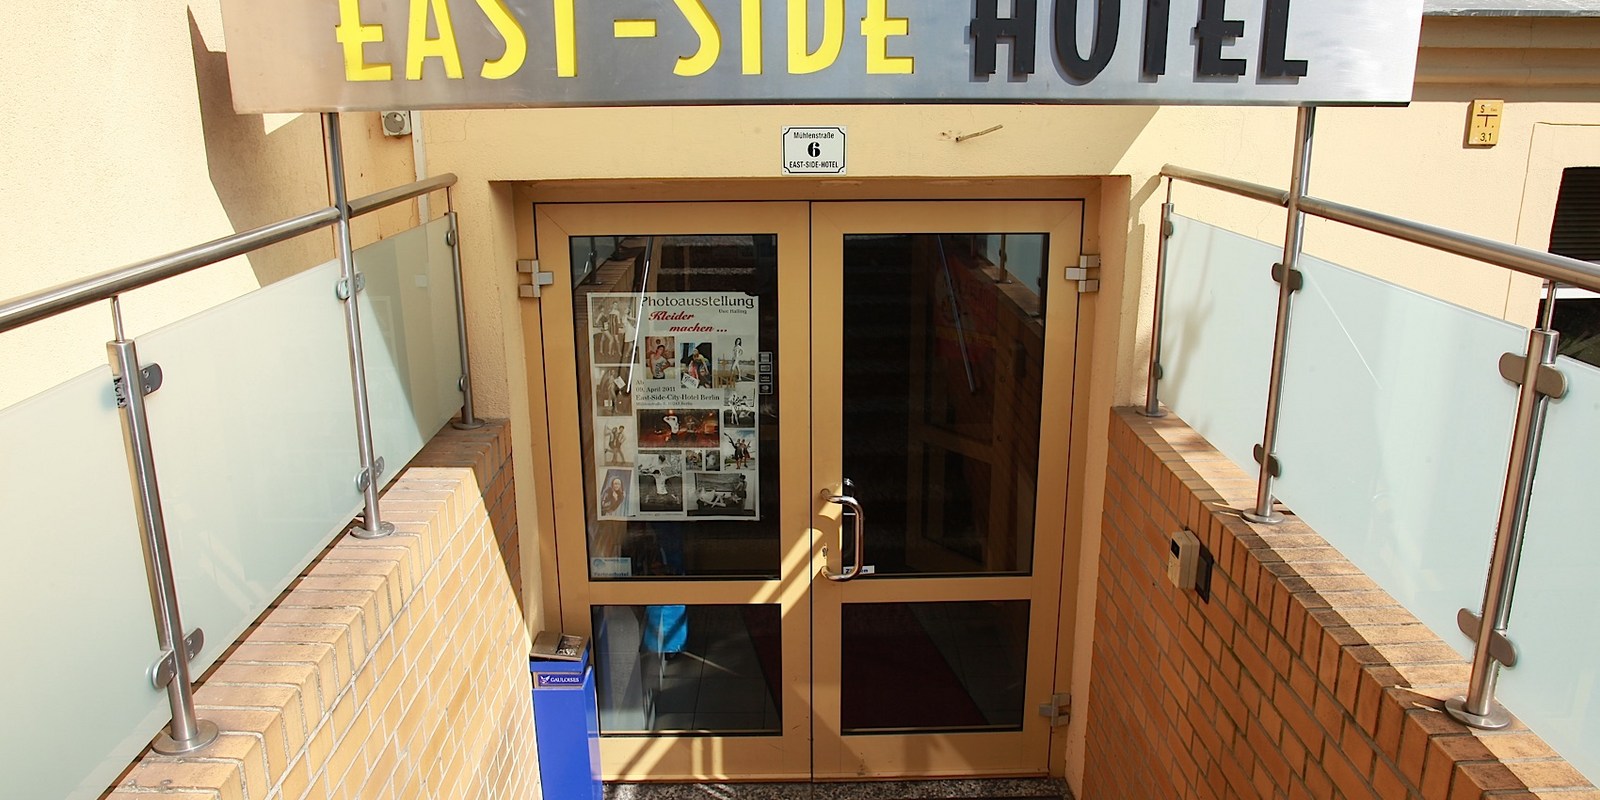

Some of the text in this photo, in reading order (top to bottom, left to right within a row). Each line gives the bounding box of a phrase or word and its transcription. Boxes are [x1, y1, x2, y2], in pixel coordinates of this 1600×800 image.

[807, 141, 821, 158] 6
[642, 296, 754, 309] Photoausstellung
[648, 310, 694, 321] Kleider
[669, 323, 714, 332] machen
